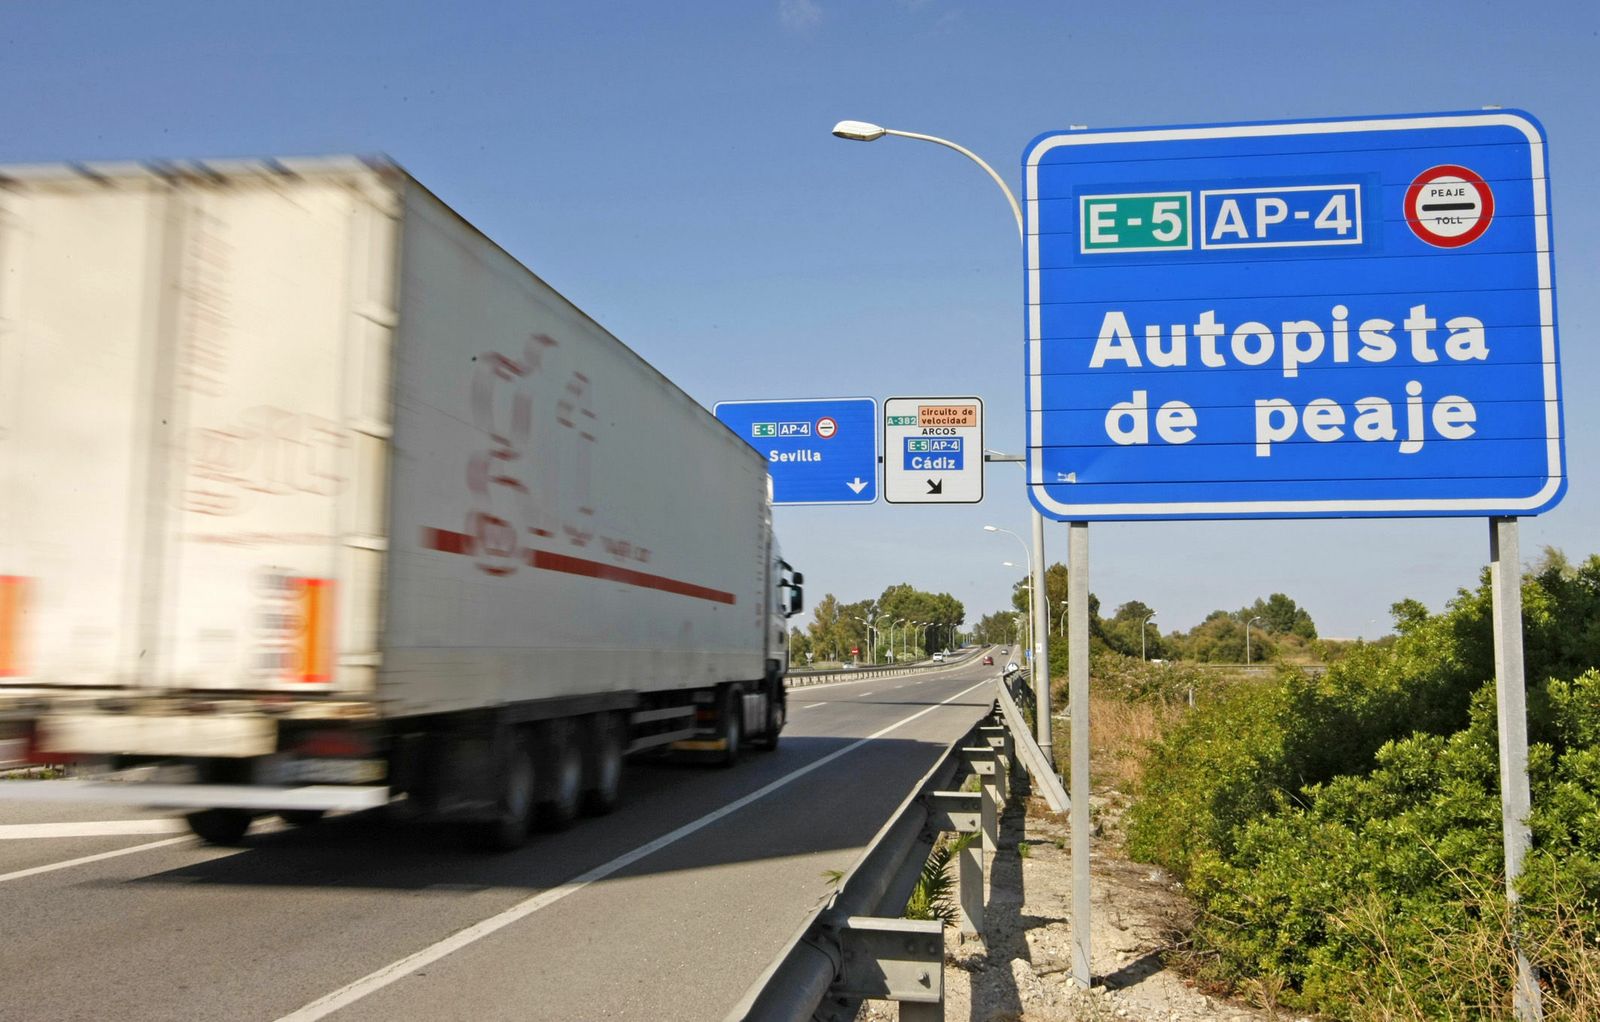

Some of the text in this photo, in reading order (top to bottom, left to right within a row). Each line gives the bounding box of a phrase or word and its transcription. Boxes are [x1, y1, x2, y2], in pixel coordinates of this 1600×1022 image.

[1431, 188, 1465, 197] PEAJE
[1089, 194, 1352, 244] E-5 AP-4
[1435, 216, 1463, 225] TOLL
[1088, 304, 1490, 377] Autopista
[921, 408, 973, 416] circuito de
[887, 417, 917, 425] A-382
[921, 417, 967, 425] velocidad
[1104, 380, 1477, 457] de peaje
[753, 424, 808, 435] E-5 AP-4
[909, 441, 958, 450] E-5 AP-4
[769, 450, 822, 462] Sevilla
[911, 456, 956, 469] Cádiz
